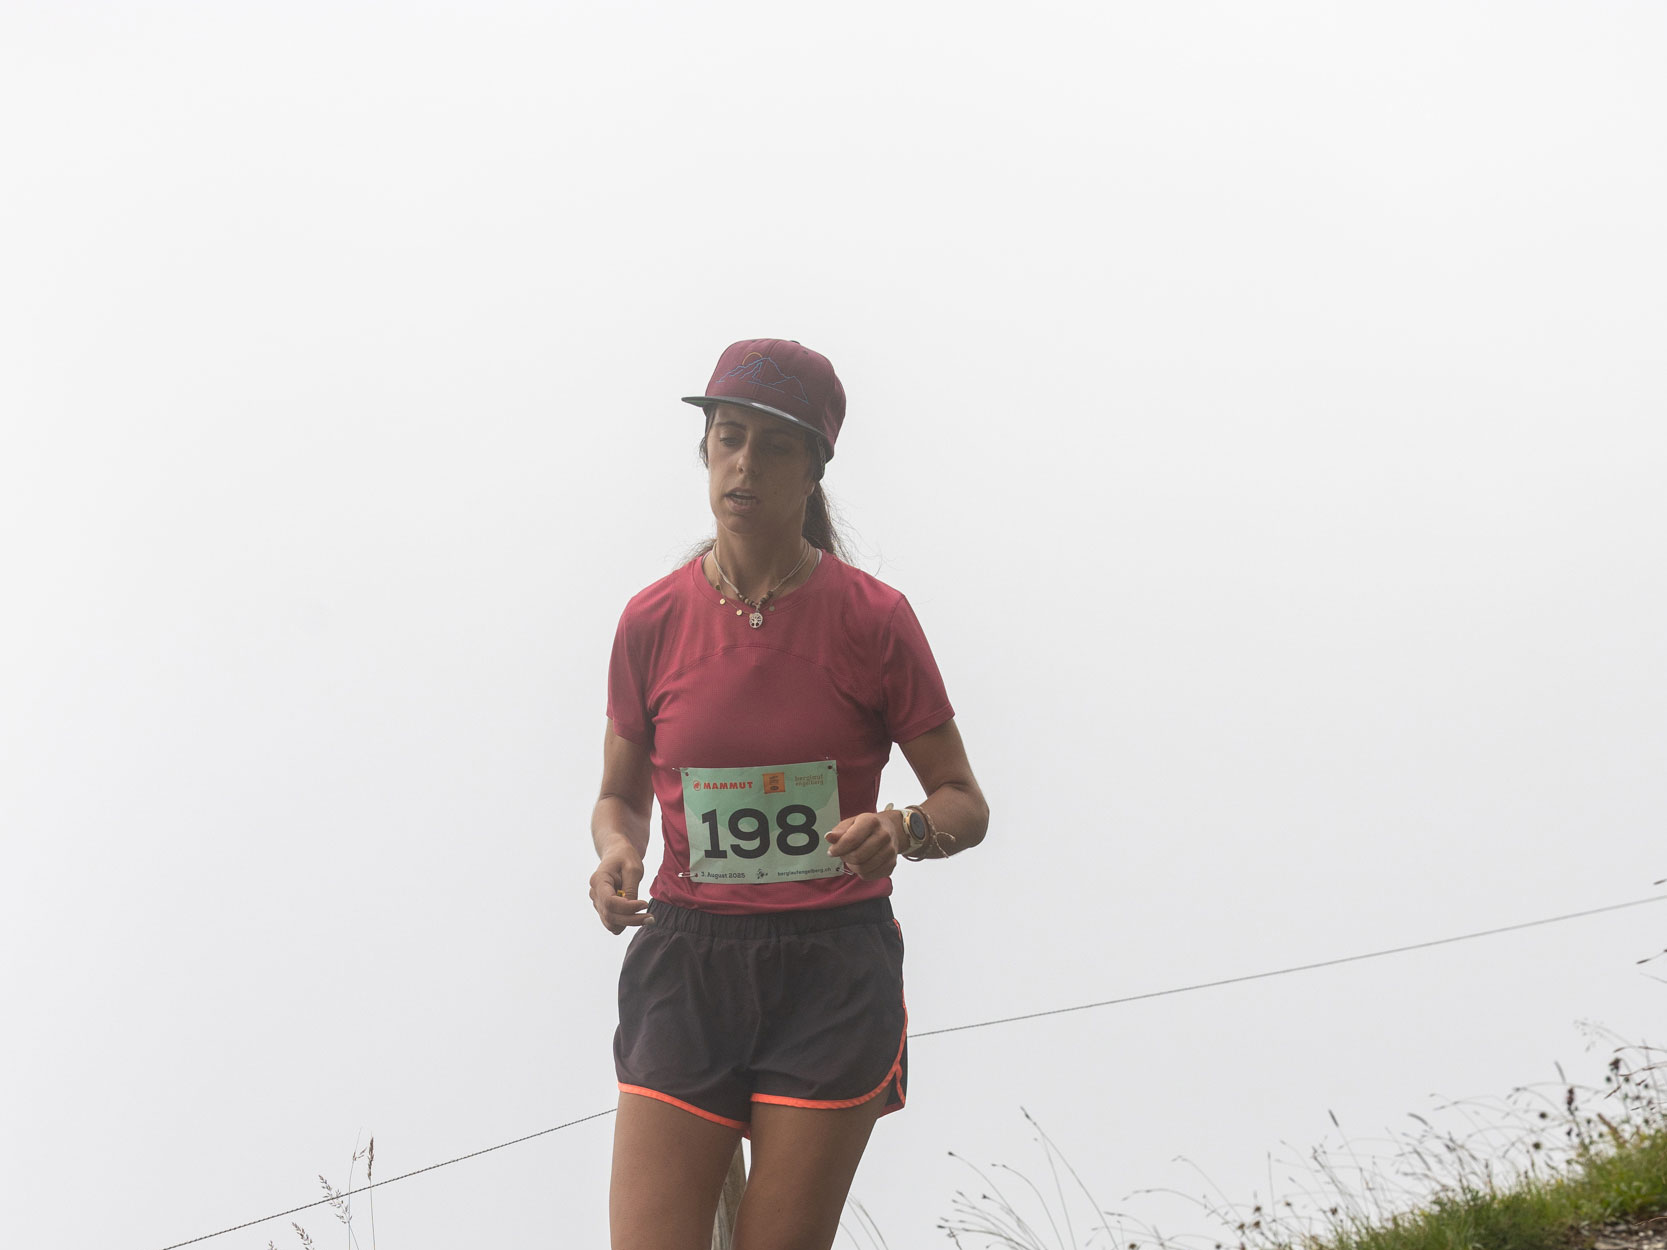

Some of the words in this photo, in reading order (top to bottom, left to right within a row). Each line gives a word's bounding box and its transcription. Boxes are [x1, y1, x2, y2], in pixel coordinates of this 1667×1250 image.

[703, 781, 753, 790] MAMMUT
[701, 804, 820, 859] 198
[707, 872, 728, 880] August
